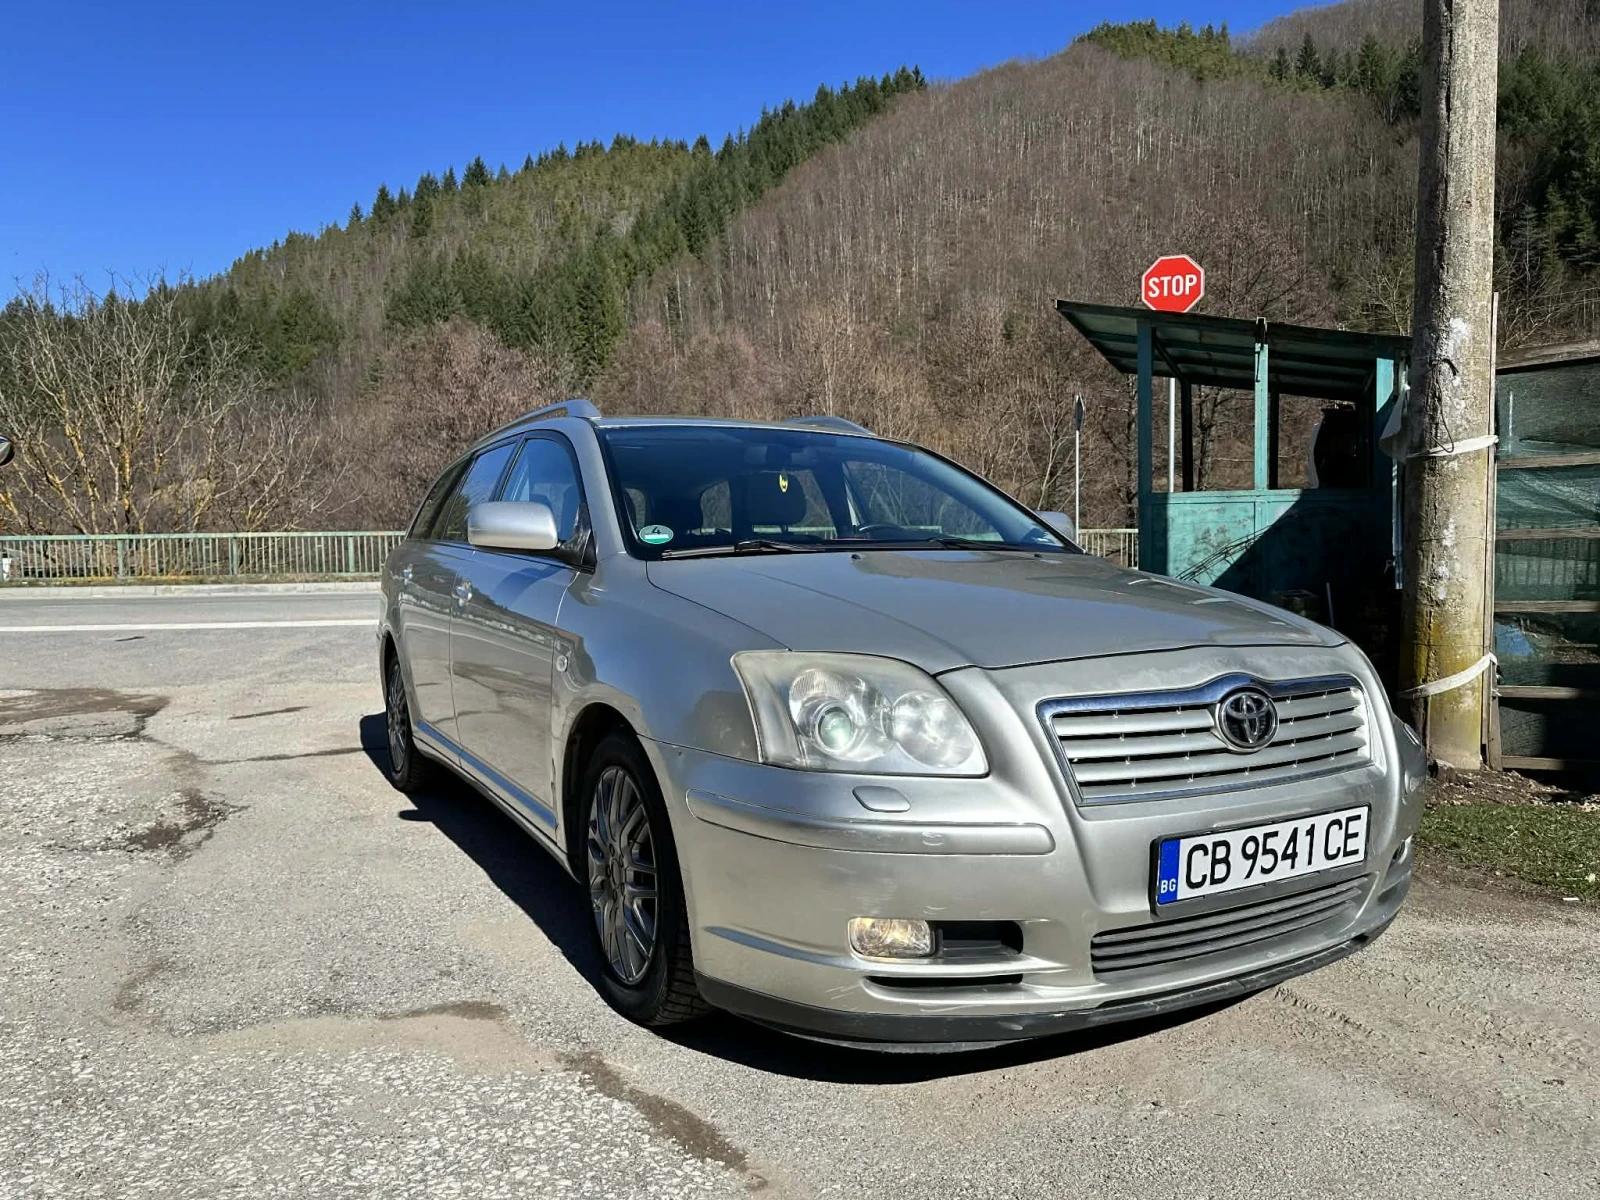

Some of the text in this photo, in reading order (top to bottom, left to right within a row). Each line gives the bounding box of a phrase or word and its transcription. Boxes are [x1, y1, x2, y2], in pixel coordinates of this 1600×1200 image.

[1148, 274, 1197, 298] STOP
[652, 526, 661, 534] 4
[1185, 815, 1362, 890] CB 9541 CE
[1160, 878, 1176, 894] BG
